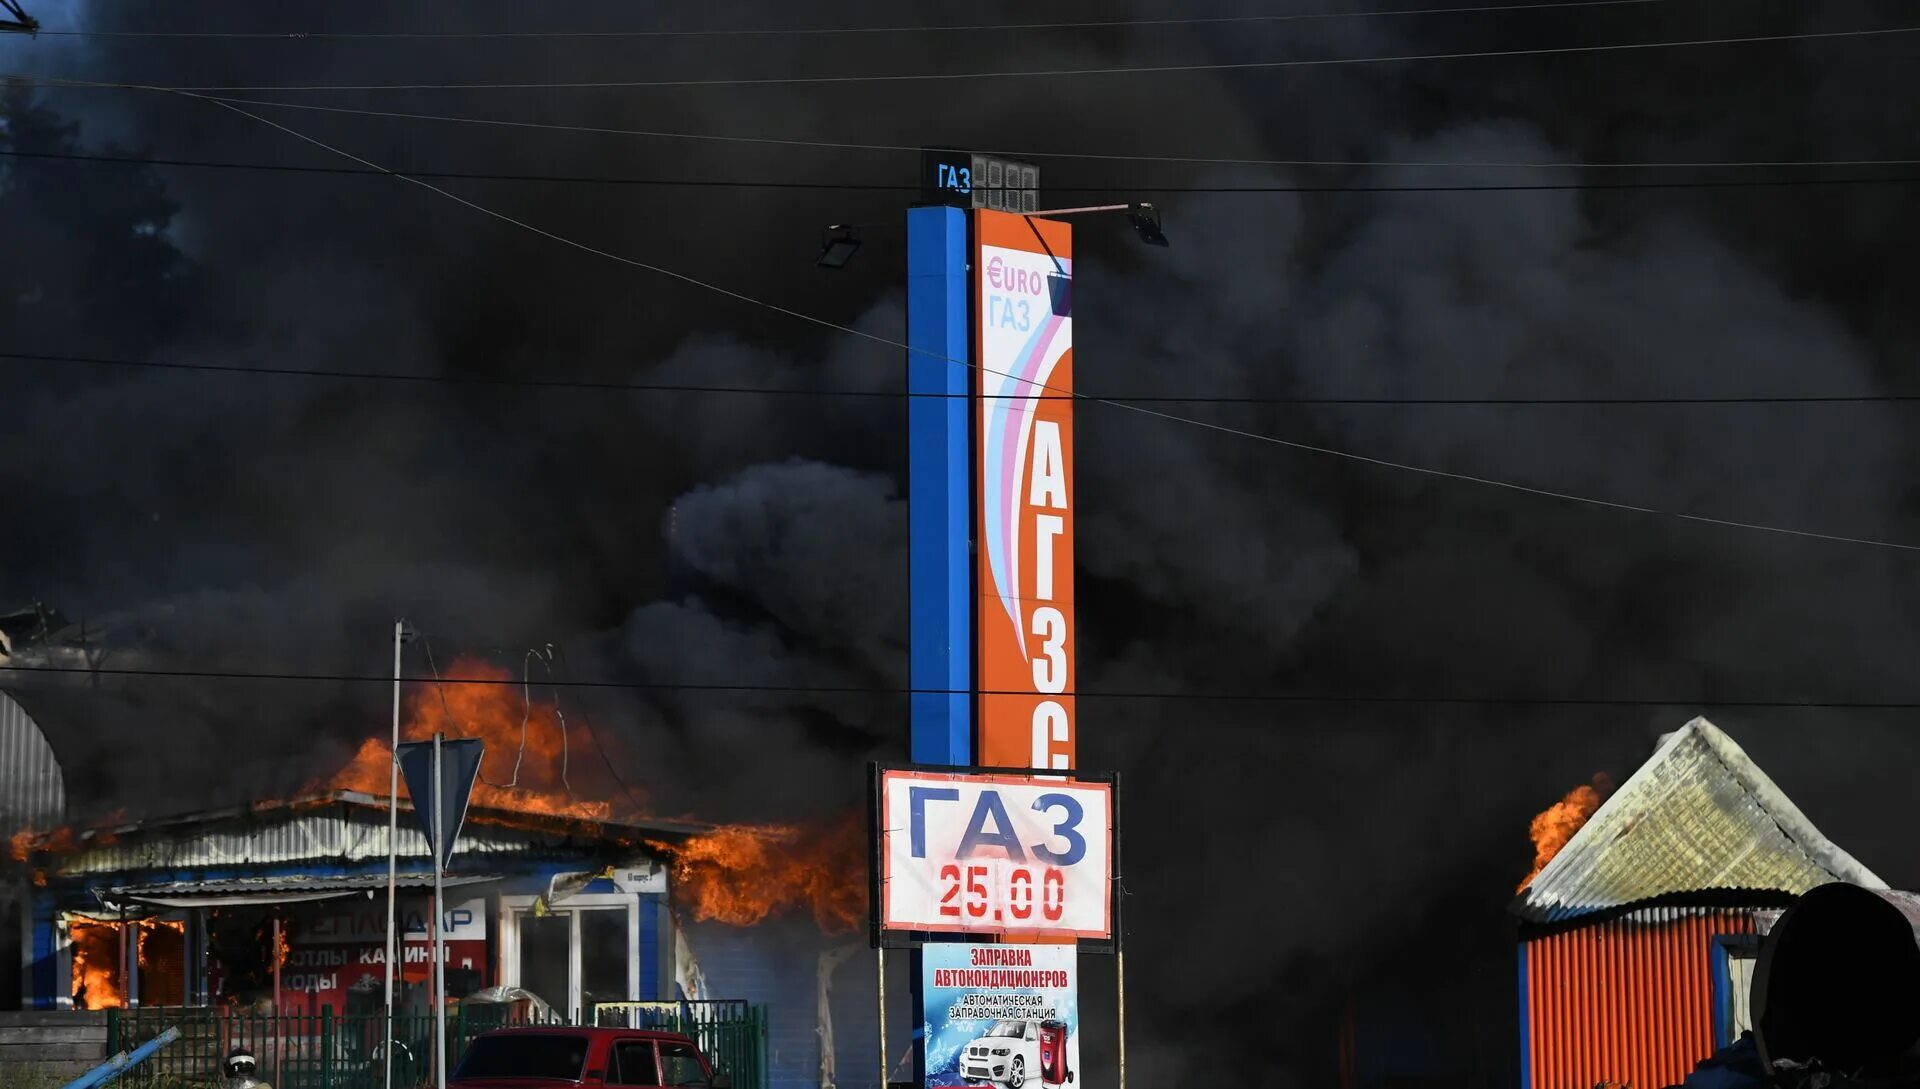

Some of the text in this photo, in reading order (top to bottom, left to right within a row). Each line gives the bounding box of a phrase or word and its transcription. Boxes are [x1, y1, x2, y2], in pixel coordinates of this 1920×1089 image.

[938, 163, 971, 194] ГАЗ
[989, 295, 1031, 332] ГАЗ
[1029, 419, 1069, 781] АГЗС
[909, 786, 1087, 866] ГАЗ
[939, 864, 1064, 921] 25.00
[289, 946, 450, 967] ОТЛЫ КАИНЫ
[971, 948, 1032, 966] ЗАПРАВКА
[935, 969, 1068, 989] АВТОКОНДИЦИОНЕРОВ
[963, 995, 1043, 1006] АВТОМАТИЧЕСКАЯ
[950, 1008, 1056, 1020] ЗАПРАВОЧНАЯ СТАНЦИЯ
